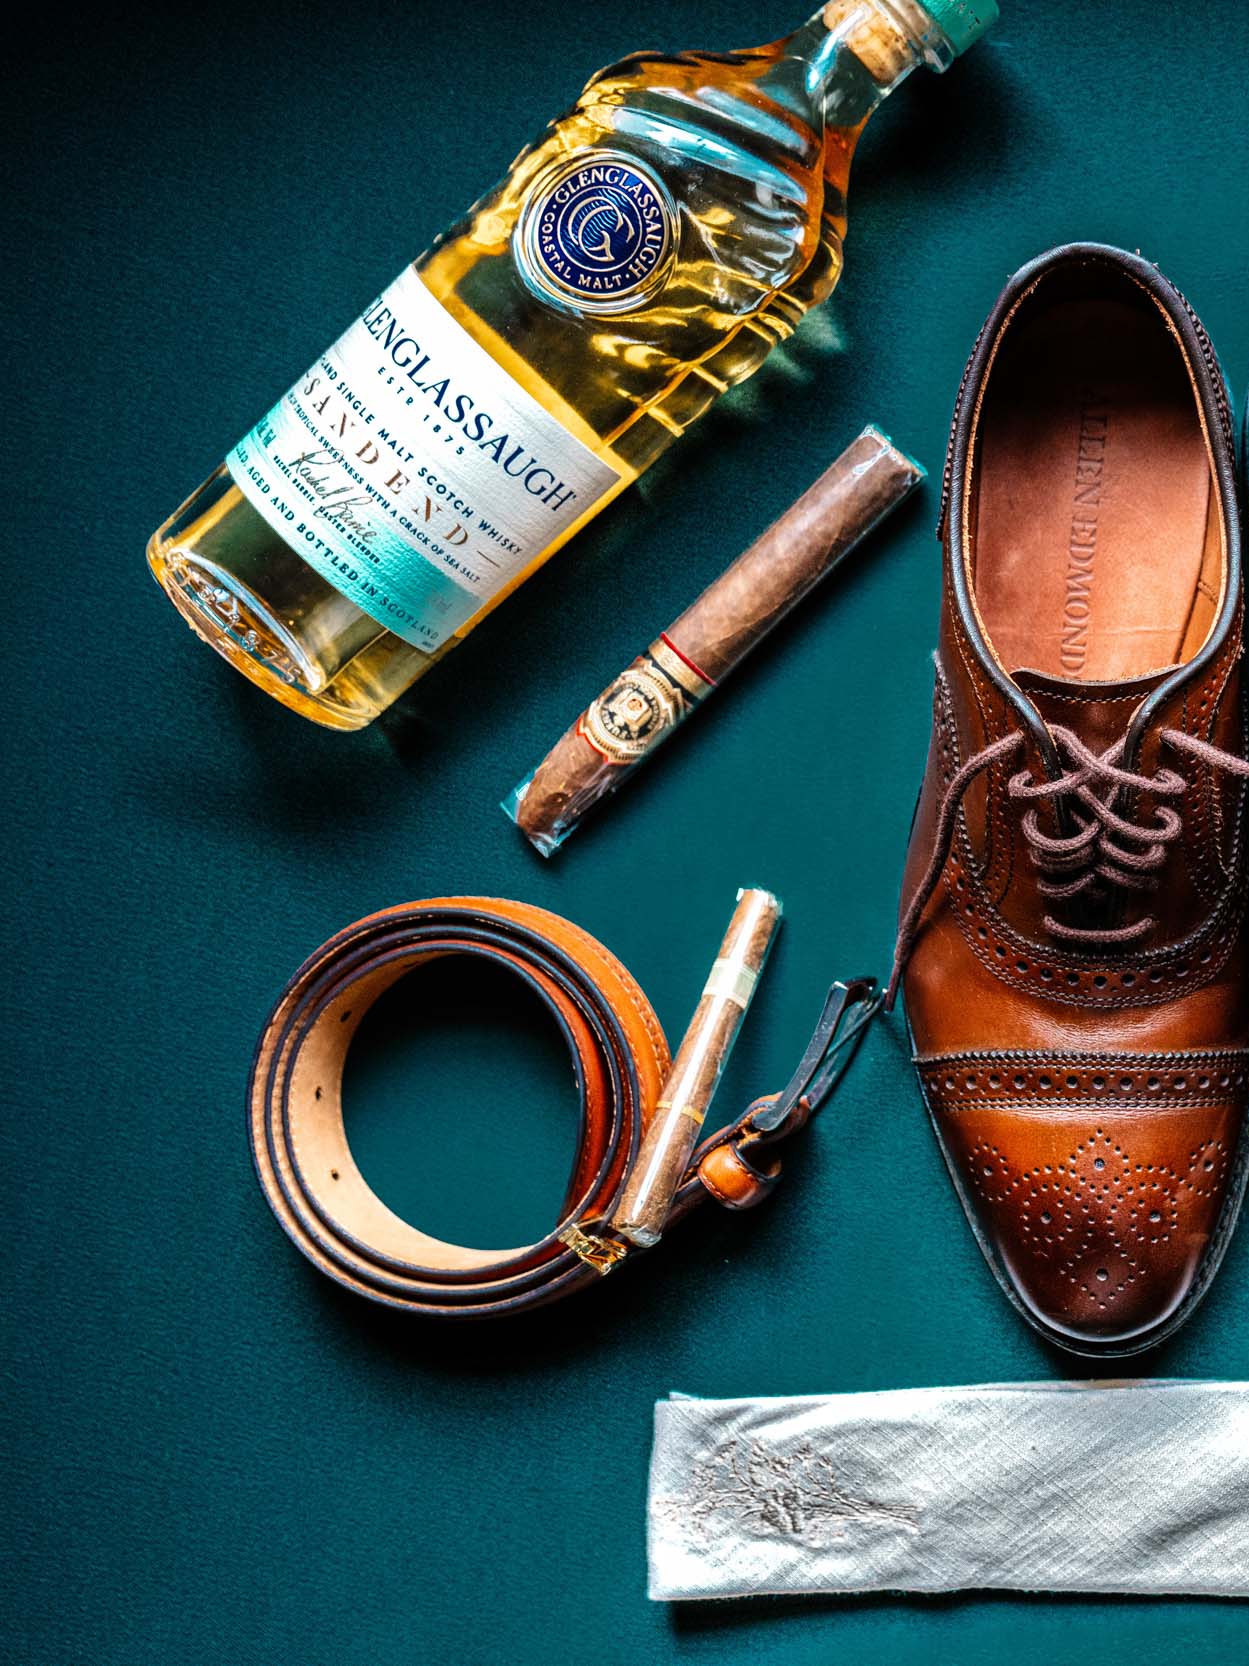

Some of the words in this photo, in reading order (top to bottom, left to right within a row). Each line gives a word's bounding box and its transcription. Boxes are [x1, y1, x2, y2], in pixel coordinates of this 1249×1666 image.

[542, 212, 571, 279] COASTAL
[578, 274, 622, 289] MALT
[555, 167, 662, 280] GLENGLASSAUGH
[304, 377, 468, 546] SANDEND
[336, 381, 375, 425] SINGLE
[377, 428, 414, 463] MALT
[417, 467, 474, 519] SCOTCH
[478, 518, 522, 554] WHISKY
[362, 299, 576, 511] LENGLASSAUGH
[423, 414, 465, 455] 1875
[246, 466, 271, 494] AGED
[270, 496, 295, 521] AND
[296, 522, 359, 582] BOTTLED
[361, 580, 379, 598] IN
[379, 597, 440, 640] SCOTLAND
[294, 404, 319, 437] TROPICAL
[318, 436, 364, 485] SWEETNESS
[365, 484, 390, 510] WITH
[389, 509, 398, 518] A
[398, 516, 431, 546] CRACK
[431, 544, 445, 556] OF
[443, 554, 460, 570] SEA
[460, 567, 481, 583] SALT
